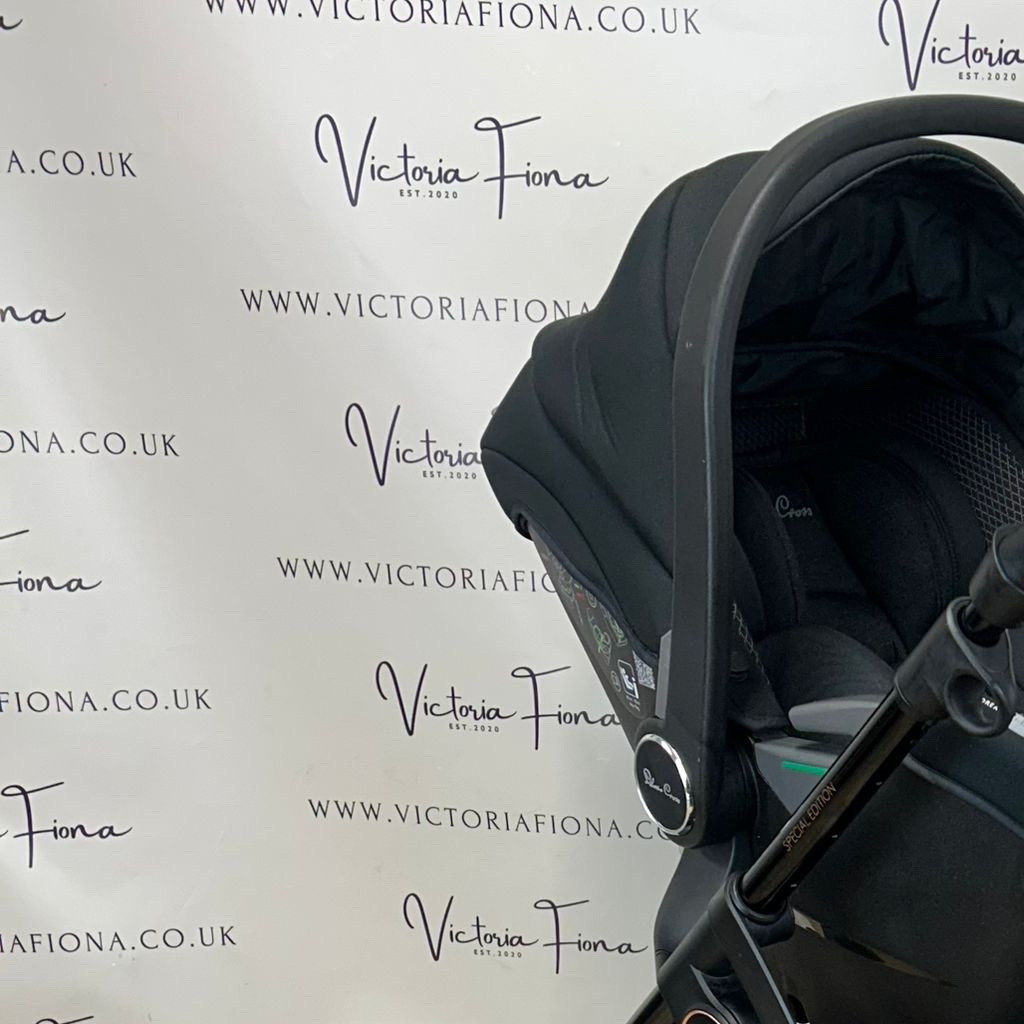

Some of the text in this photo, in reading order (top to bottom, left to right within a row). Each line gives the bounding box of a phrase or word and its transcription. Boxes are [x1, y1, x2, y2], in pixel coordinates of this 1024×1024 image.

[957, 71, 1018, 81] EST.2020
[314, 113, 610, 220] Victoria Fiona
[399, 188, 459, 199] EST.2020
[345, 403, 483, 486] Victoria
[422, 470, 478, 480] EST.2020
[375, 660, 622, 750] Victoria Fiona
[448, 722, 501, 733] EST.2020
[2, 781, 133, 868] Fiona
[782, 783, 837, 851] SPECIAL EDITION
[403, 892, 649, 974] Victoria Fiona
[473, 949, 523, 958] EST.2020
